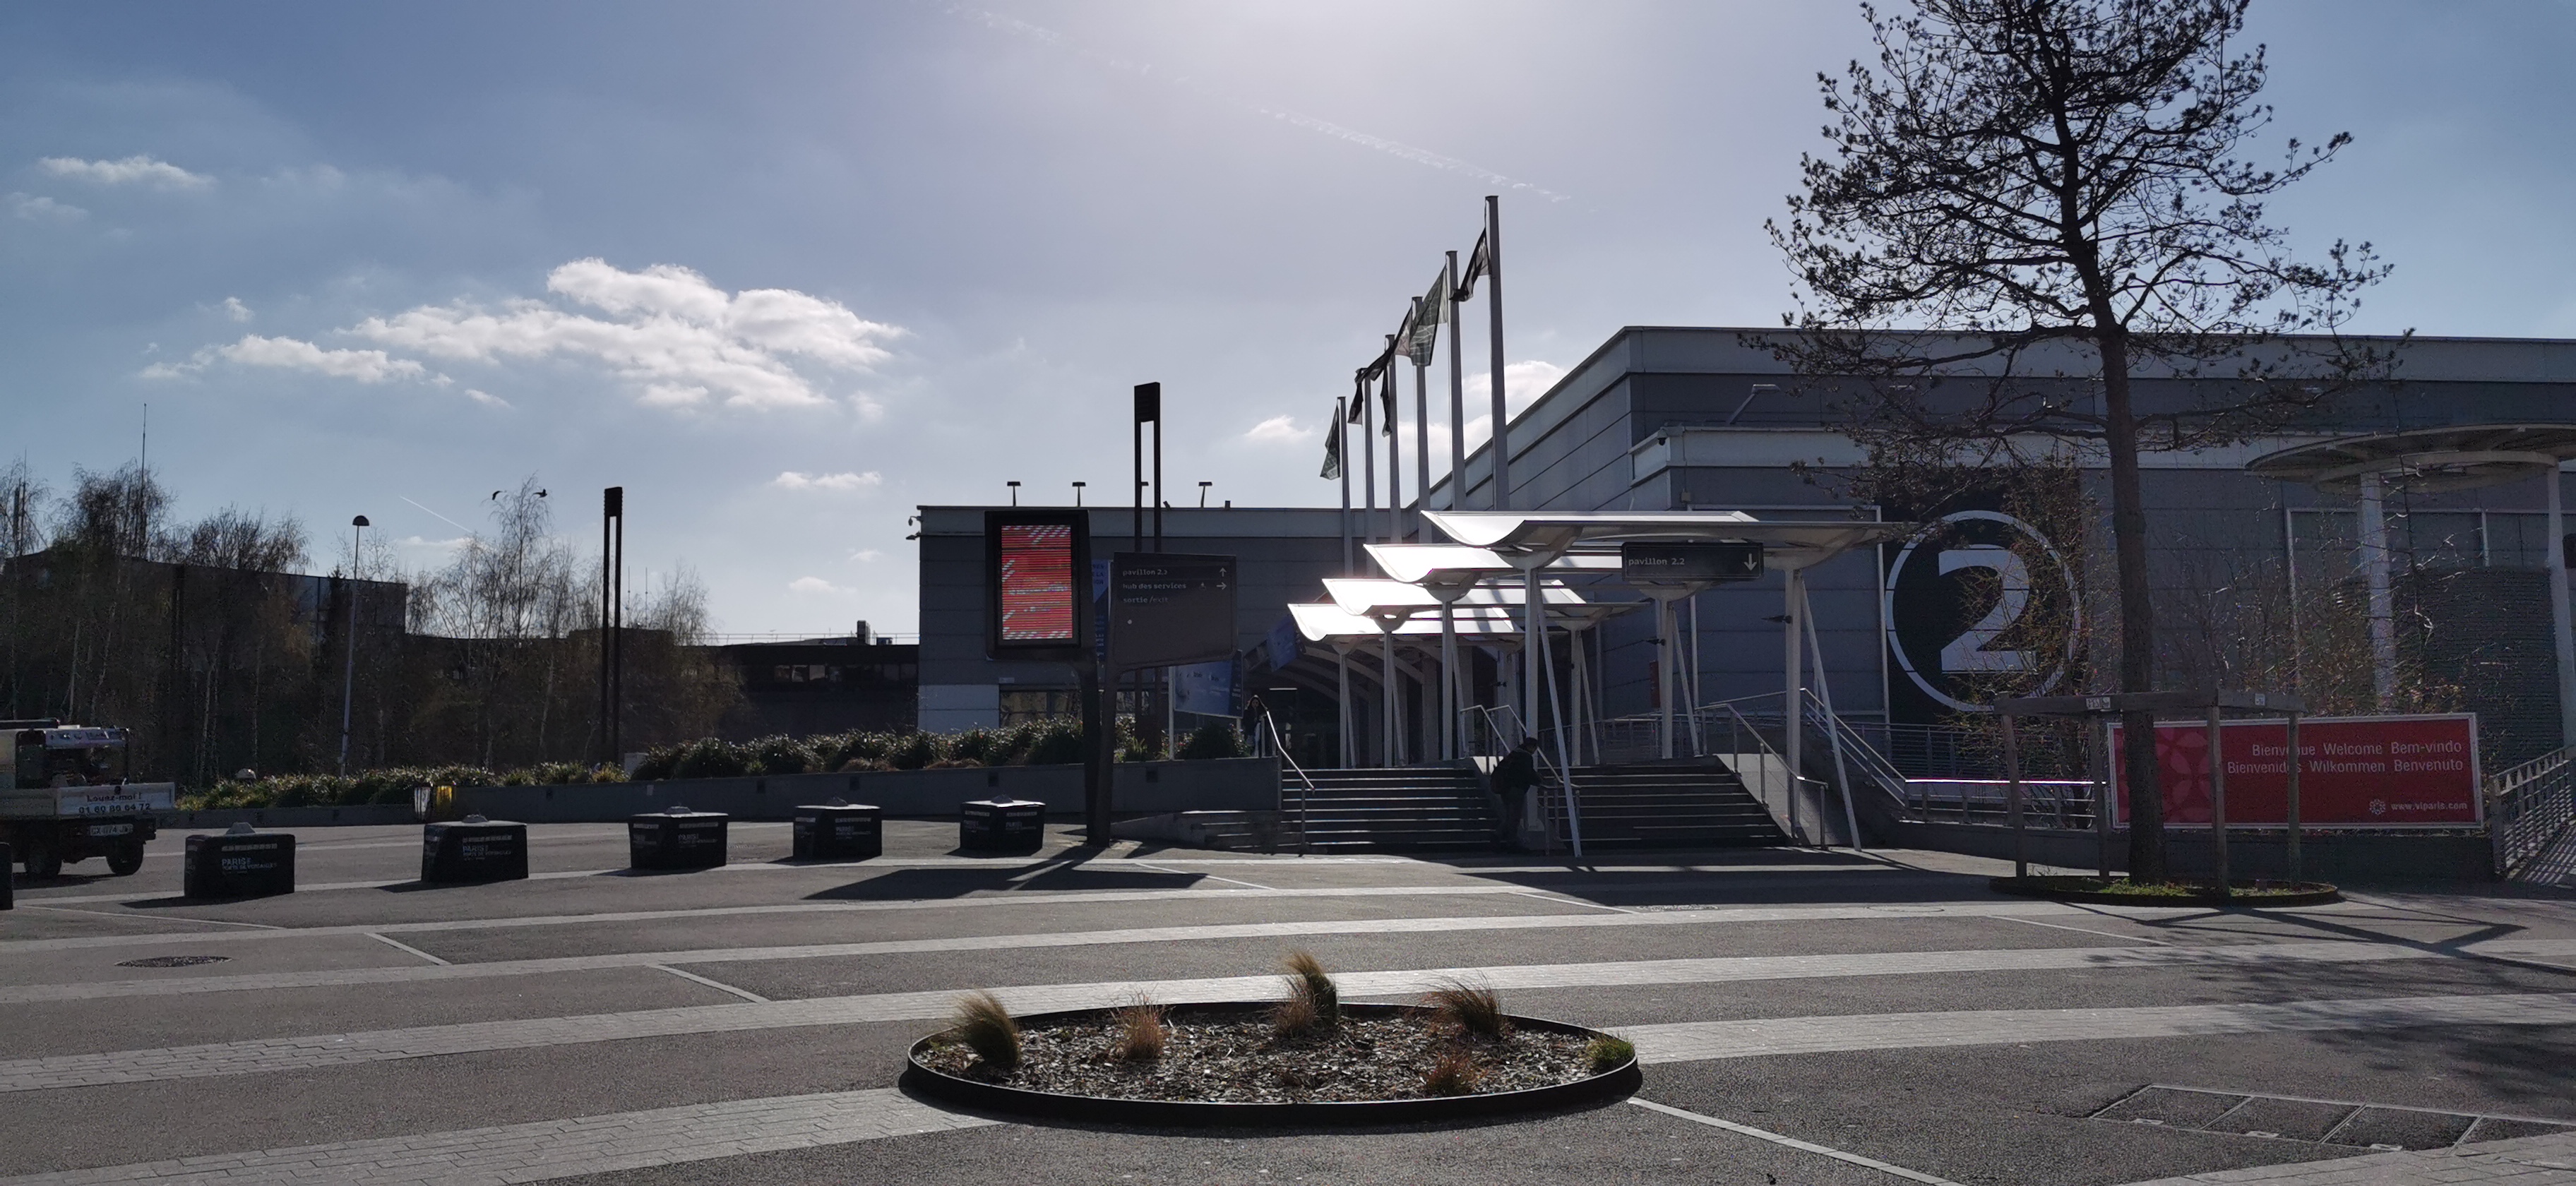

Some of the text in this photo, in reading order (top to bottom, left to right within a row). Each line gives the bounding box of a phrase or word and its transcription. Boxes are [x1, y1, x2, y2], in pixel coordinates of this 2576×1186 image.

[1628, 557, 1667, 566] pavillon
[1122, 568, 1156, 577] pavillon
[1938, 544, 2037, 674] 2
[2323, 742, 2383, 755] Welcome
[2391, 740, 2462, 755] Bem-vindo
[2227, 759, 2464, 774] Bienvenids Wilkommen Benvenuto
[2390, 801, 2468, 812] www.viparis.com
[222, 857, 246, 865] PARIS
